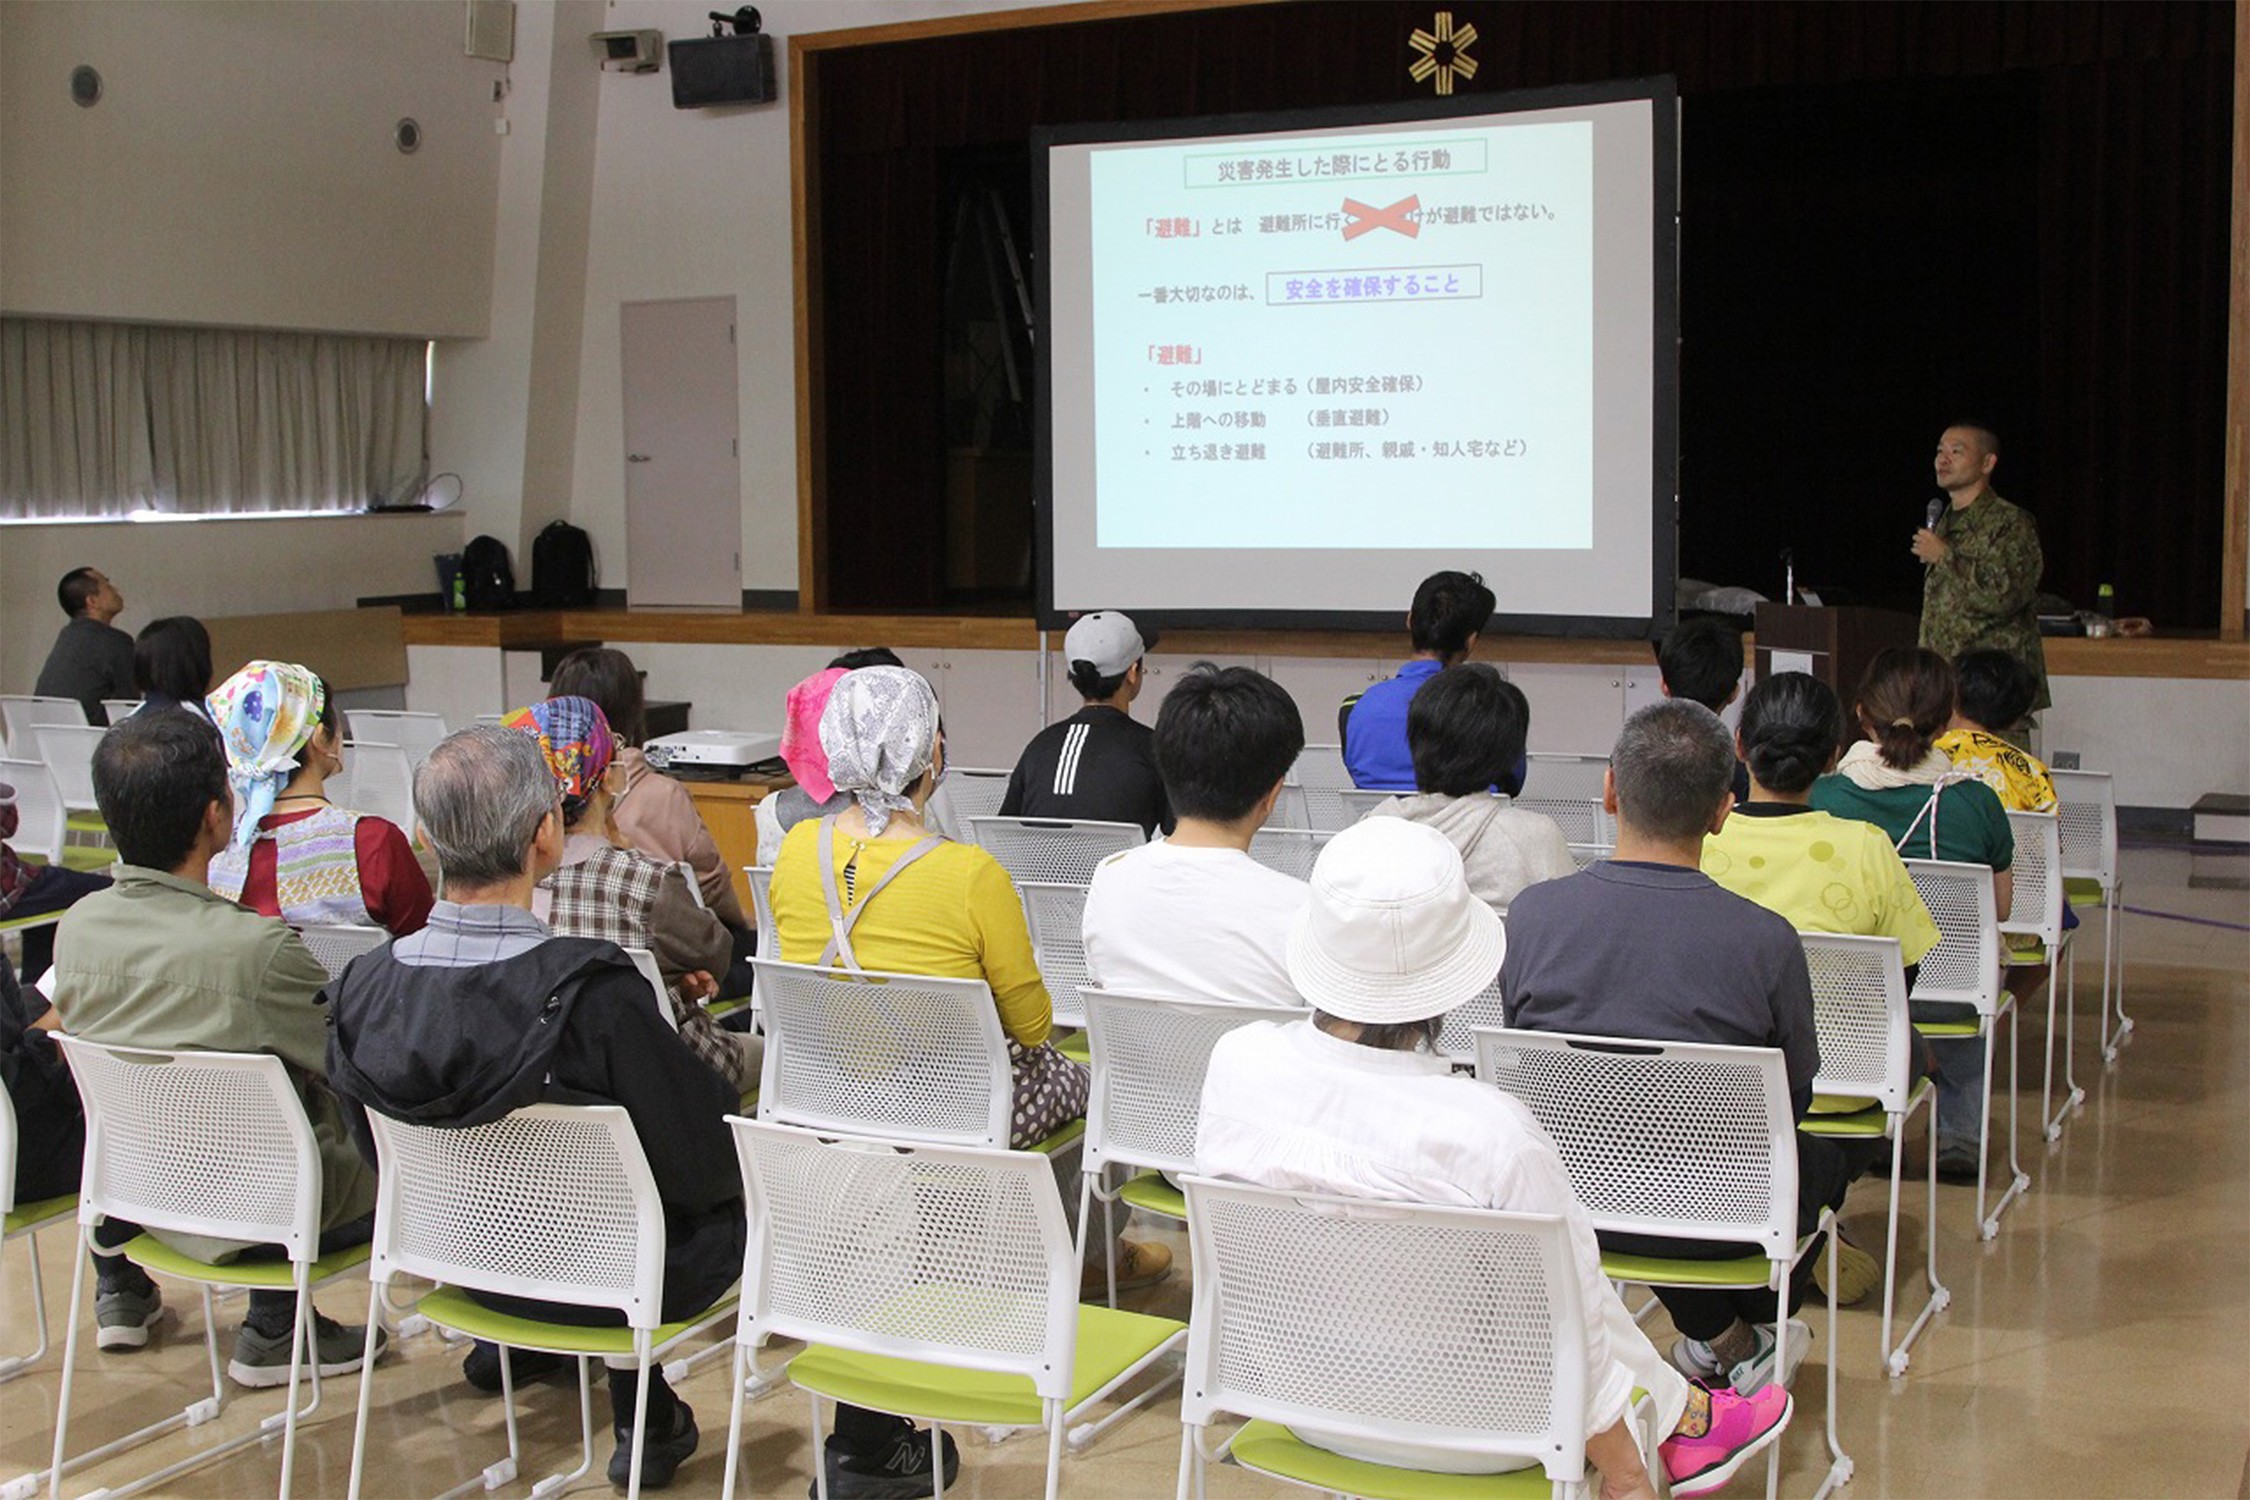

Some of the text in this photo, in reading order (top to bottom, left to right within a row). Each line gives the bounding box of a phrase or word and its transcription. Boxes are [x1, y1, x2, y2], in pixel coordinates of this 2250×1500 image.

[1217, 148, 1452, 182] 災害発生した際にとる行動
[1138, 271, 1461, 304] 一番大切なのは、 安全を確保すること
[1148, 345, 1202, 365] 「避難」
[1170, 408, 1391, 429] 上階への移動 （垂直避難）
[1171, 442, 1267, 461] 立ち退き避難
